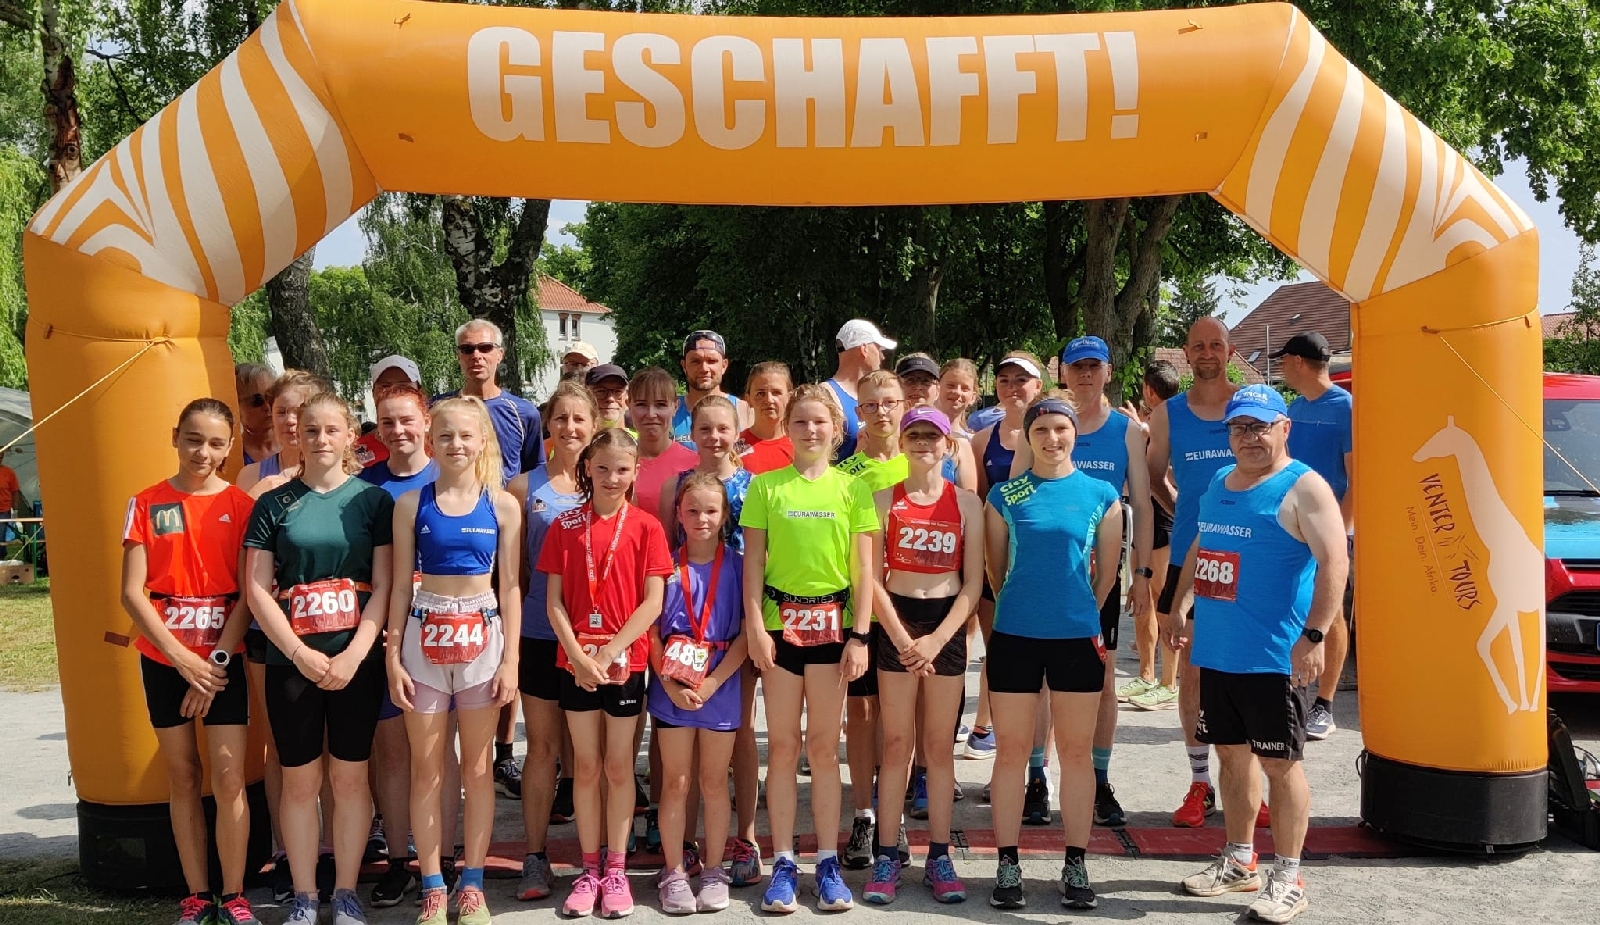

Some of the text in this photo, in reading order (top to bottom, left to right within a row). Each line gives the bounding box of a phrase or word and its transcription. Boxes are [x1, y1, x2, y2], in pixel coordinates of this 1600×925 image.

[466, 26, 1139, 150] GESCHAFFT!
[1193, 448, 1236, 461] EURAWA
[898, 527, 957, 554] 2239
[1418, 473, 1483, 611] VENTER TOURS
[294, 589, 355, 618] 2260
[165, 606, 225, 629] 2265
[783, 608, 838, 631] 2231
[423, 623, 484, 647] 2244
[1252, 739, 1285, 751] TRAINER
